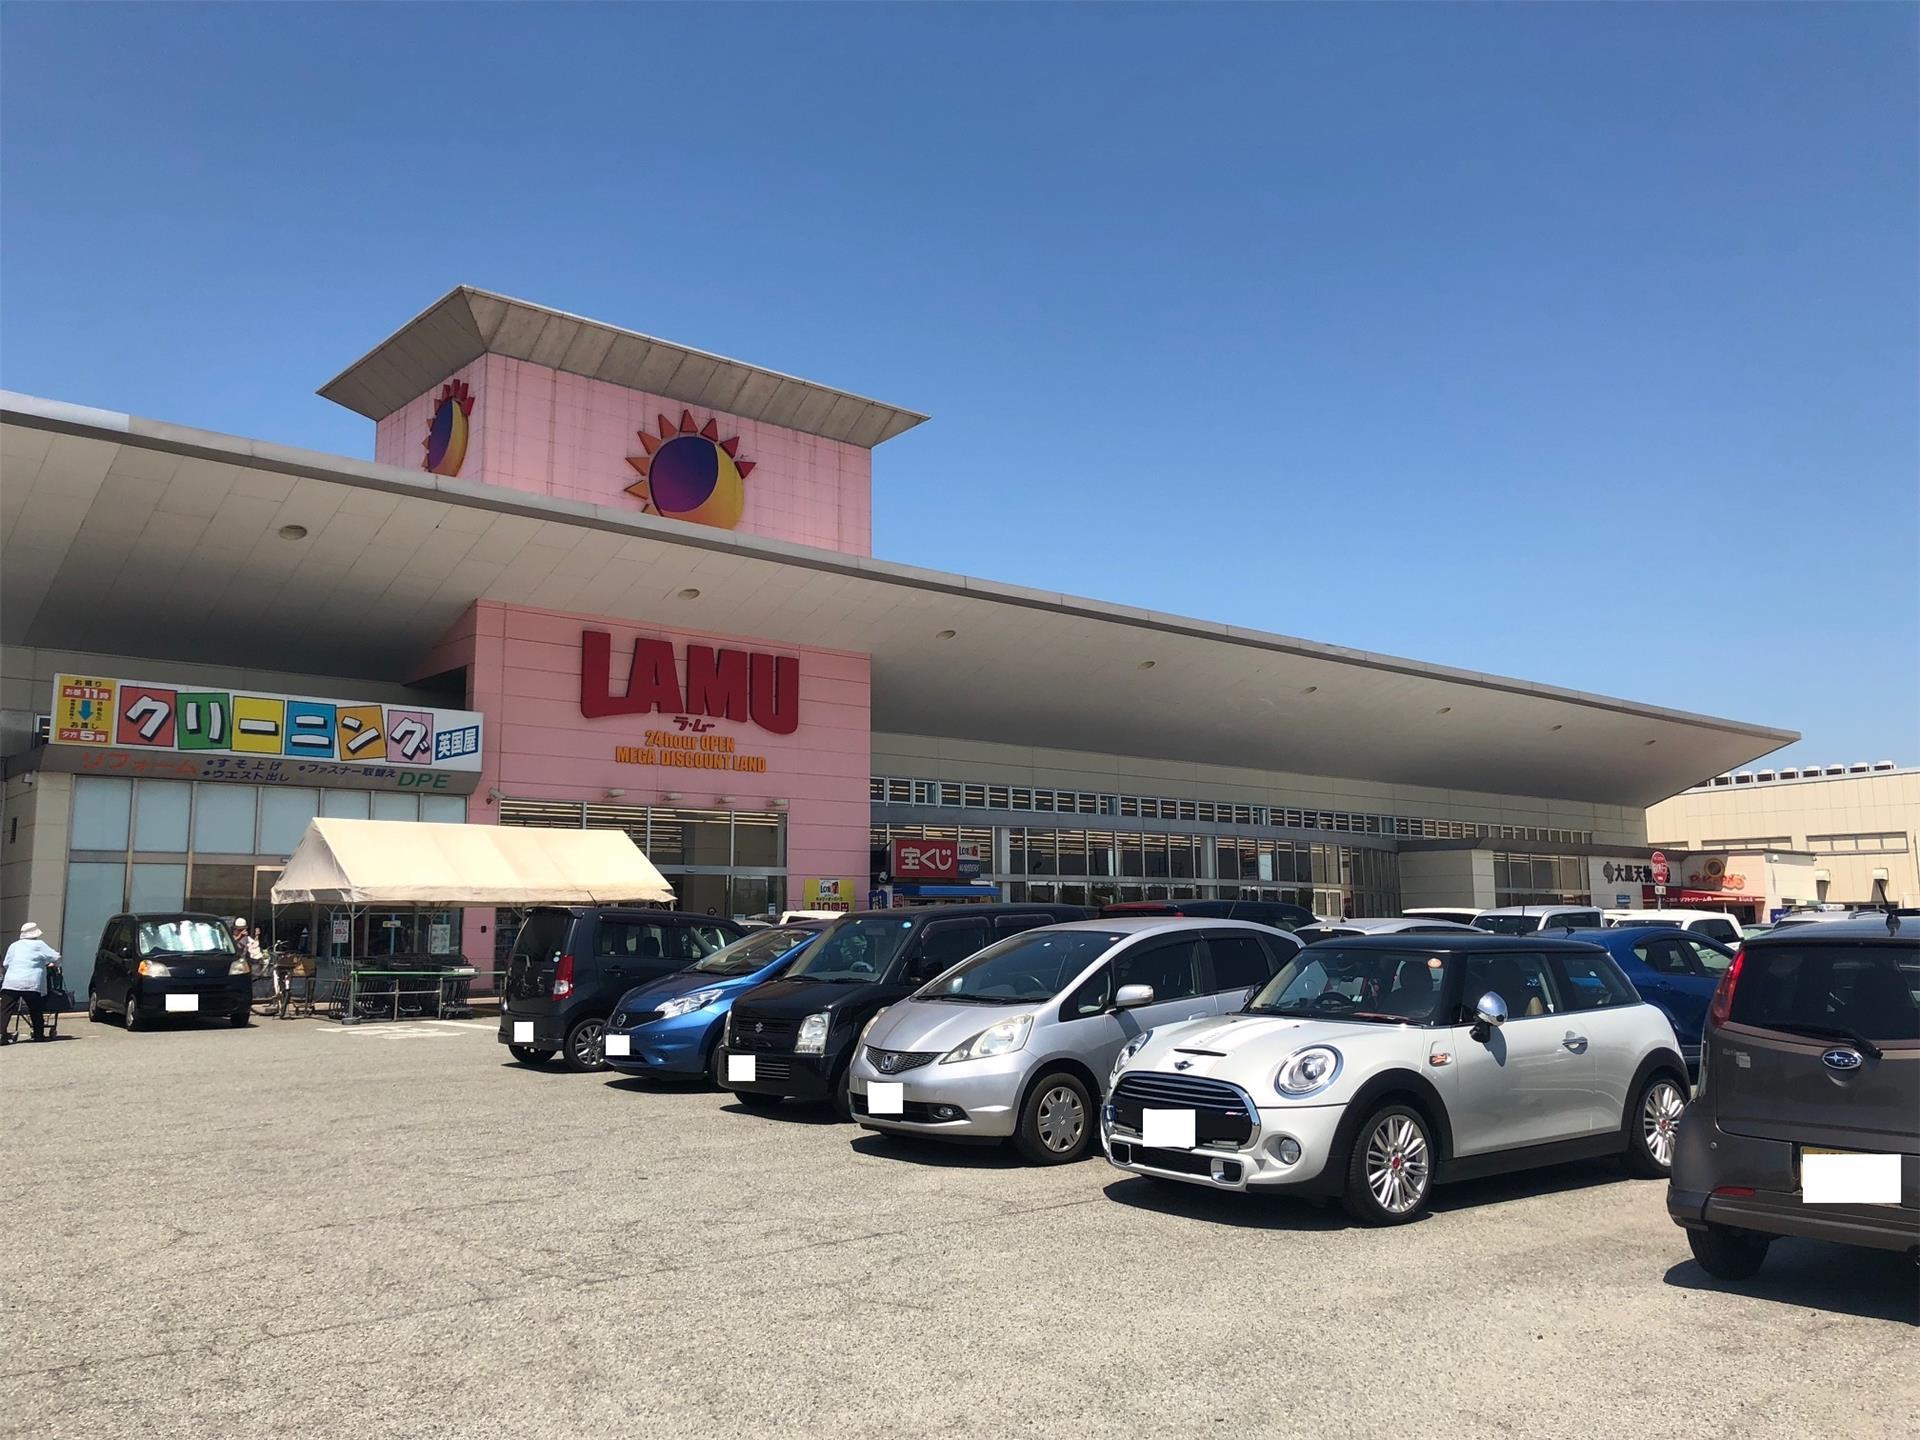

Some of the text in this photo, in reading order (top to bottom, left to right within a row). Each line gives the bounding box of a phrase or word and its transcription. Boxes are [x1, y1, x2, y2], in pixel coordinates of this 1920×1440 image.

[581, 630, 799, 735] LAMU
[125, 695, 429, 760] クリーニング
[438, 728, 476, 758] 英国屋
[645, 730, 736, 753] 24hour OPEN
[83, 751, 197, 775] リフォーム
[615, 746, 767, 773] MEGA DISCOUNT LAND
[397, 771, 451, 789] DPE
[901, 847, 952, 871] 宝くじ
